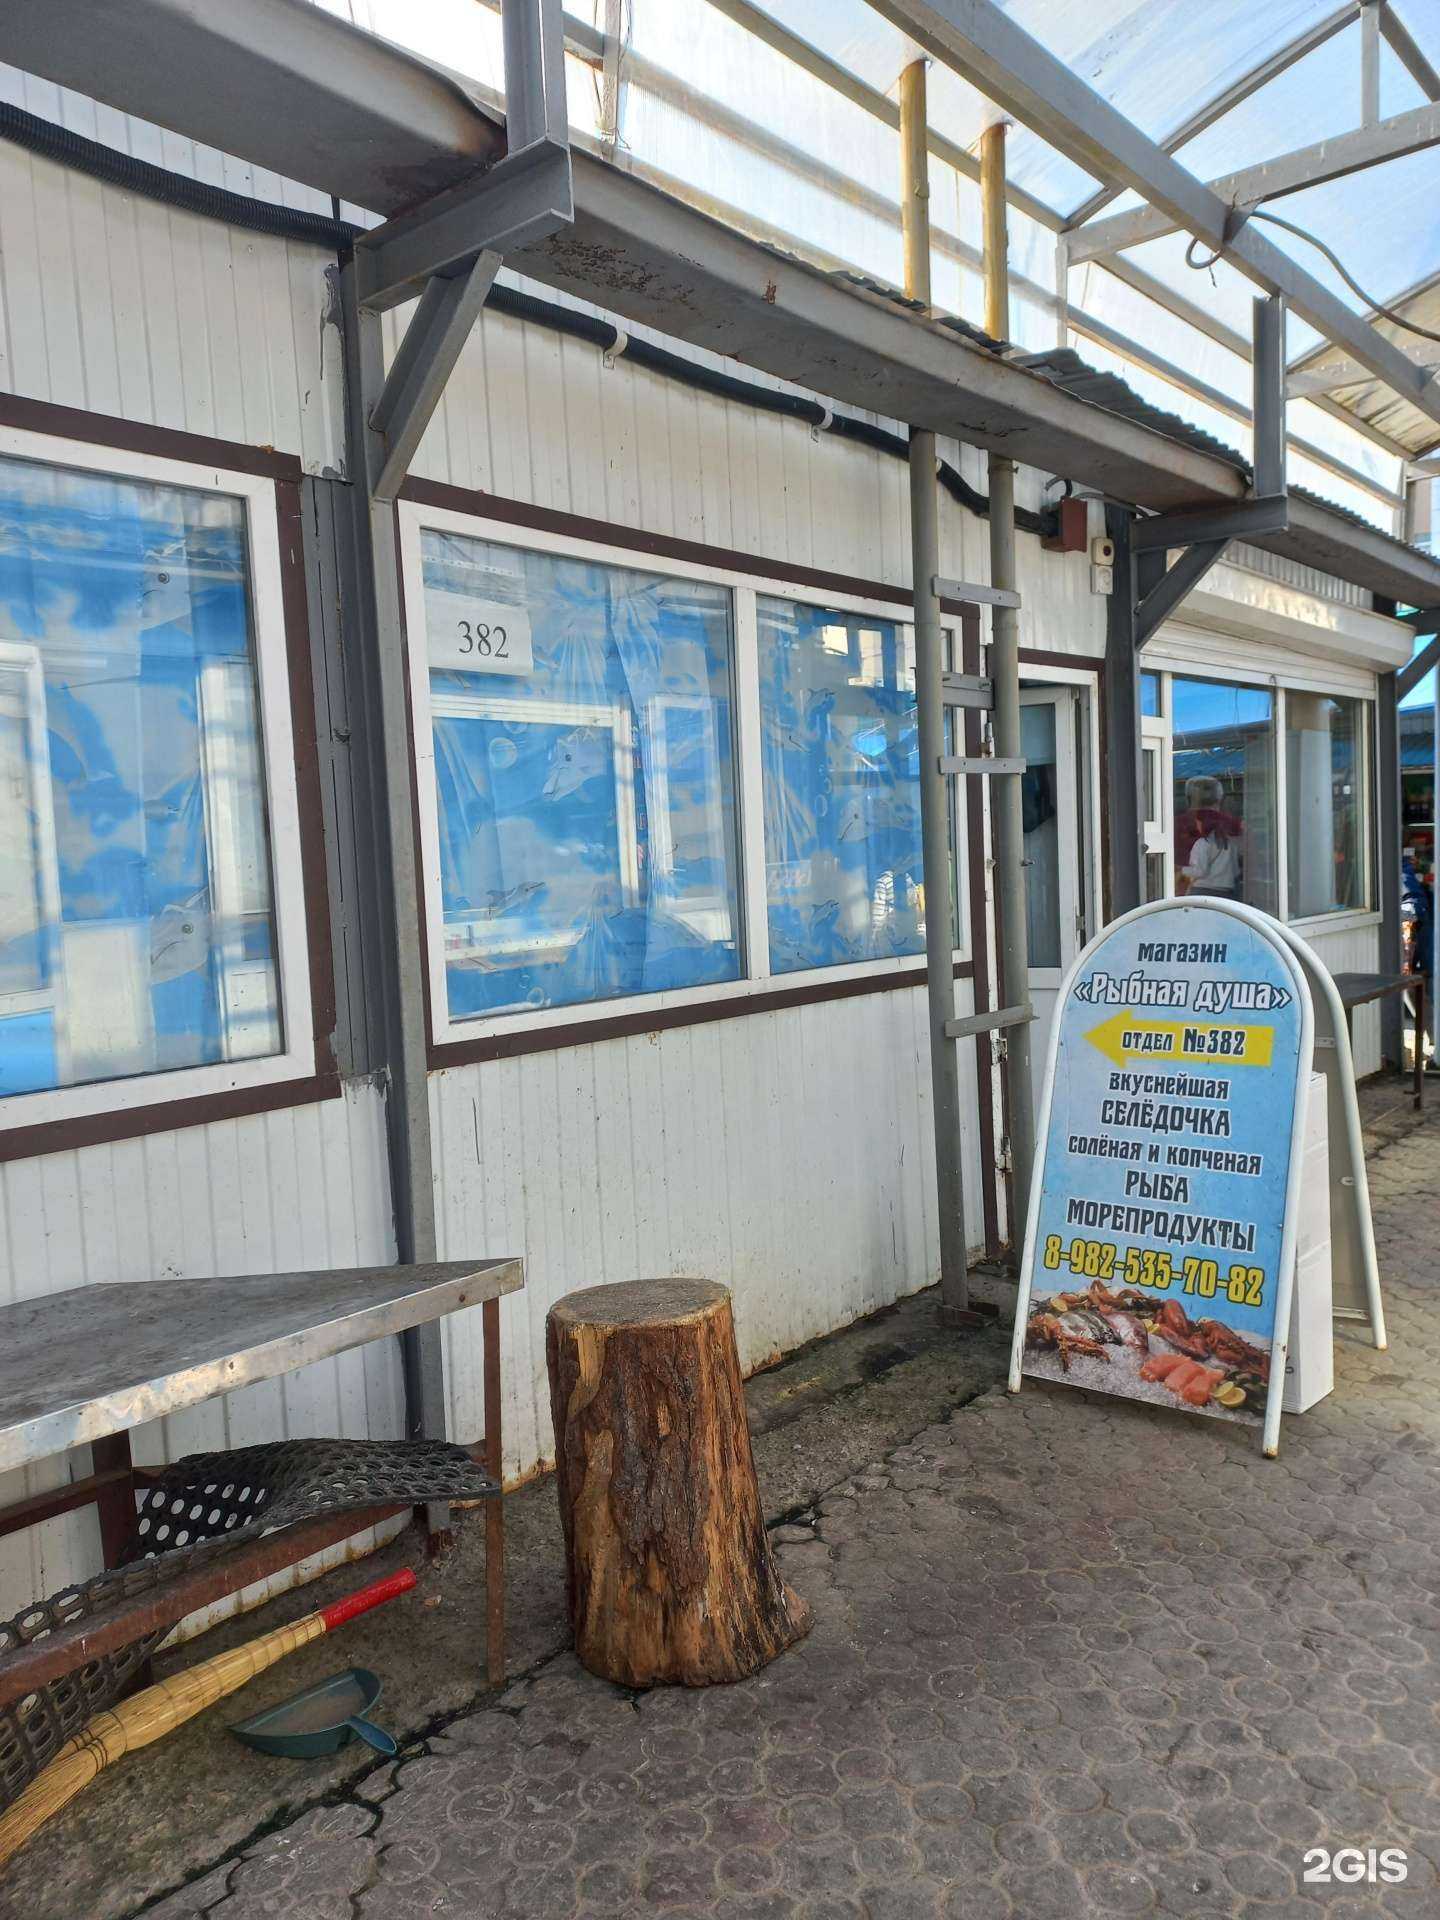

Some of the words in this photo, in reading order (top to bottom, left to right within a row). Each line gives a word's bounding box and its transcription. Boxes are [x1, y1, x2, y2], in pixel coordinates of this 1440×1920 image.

[457, 620, 509, 659] 382
[1137, 942, 1228, 964] магазин
[1074, 970, 1190, 1008] «Рыбная
[1193, 980, 1292, 1014] душа»
[1183, 1028, 1246, 1056] №382
[1108, 1072, 1230, 1100] вкуснейшая
[1101, 1099, 1231, 1137] СЕЛЁДОЧКА
[1068, 1134, 1143, 1161] солёная
[1148, 1144, 1160, 1163] и
[1167, 1145, 1262, 1176] копченая
[1125, 1170, 1188, 1203] РЫБА
[1067, 1198, 1255, 1252] МОРЕПРОДУКТЫ
[1044, 1234, 1264, 1307] 8-982-535-70-82
